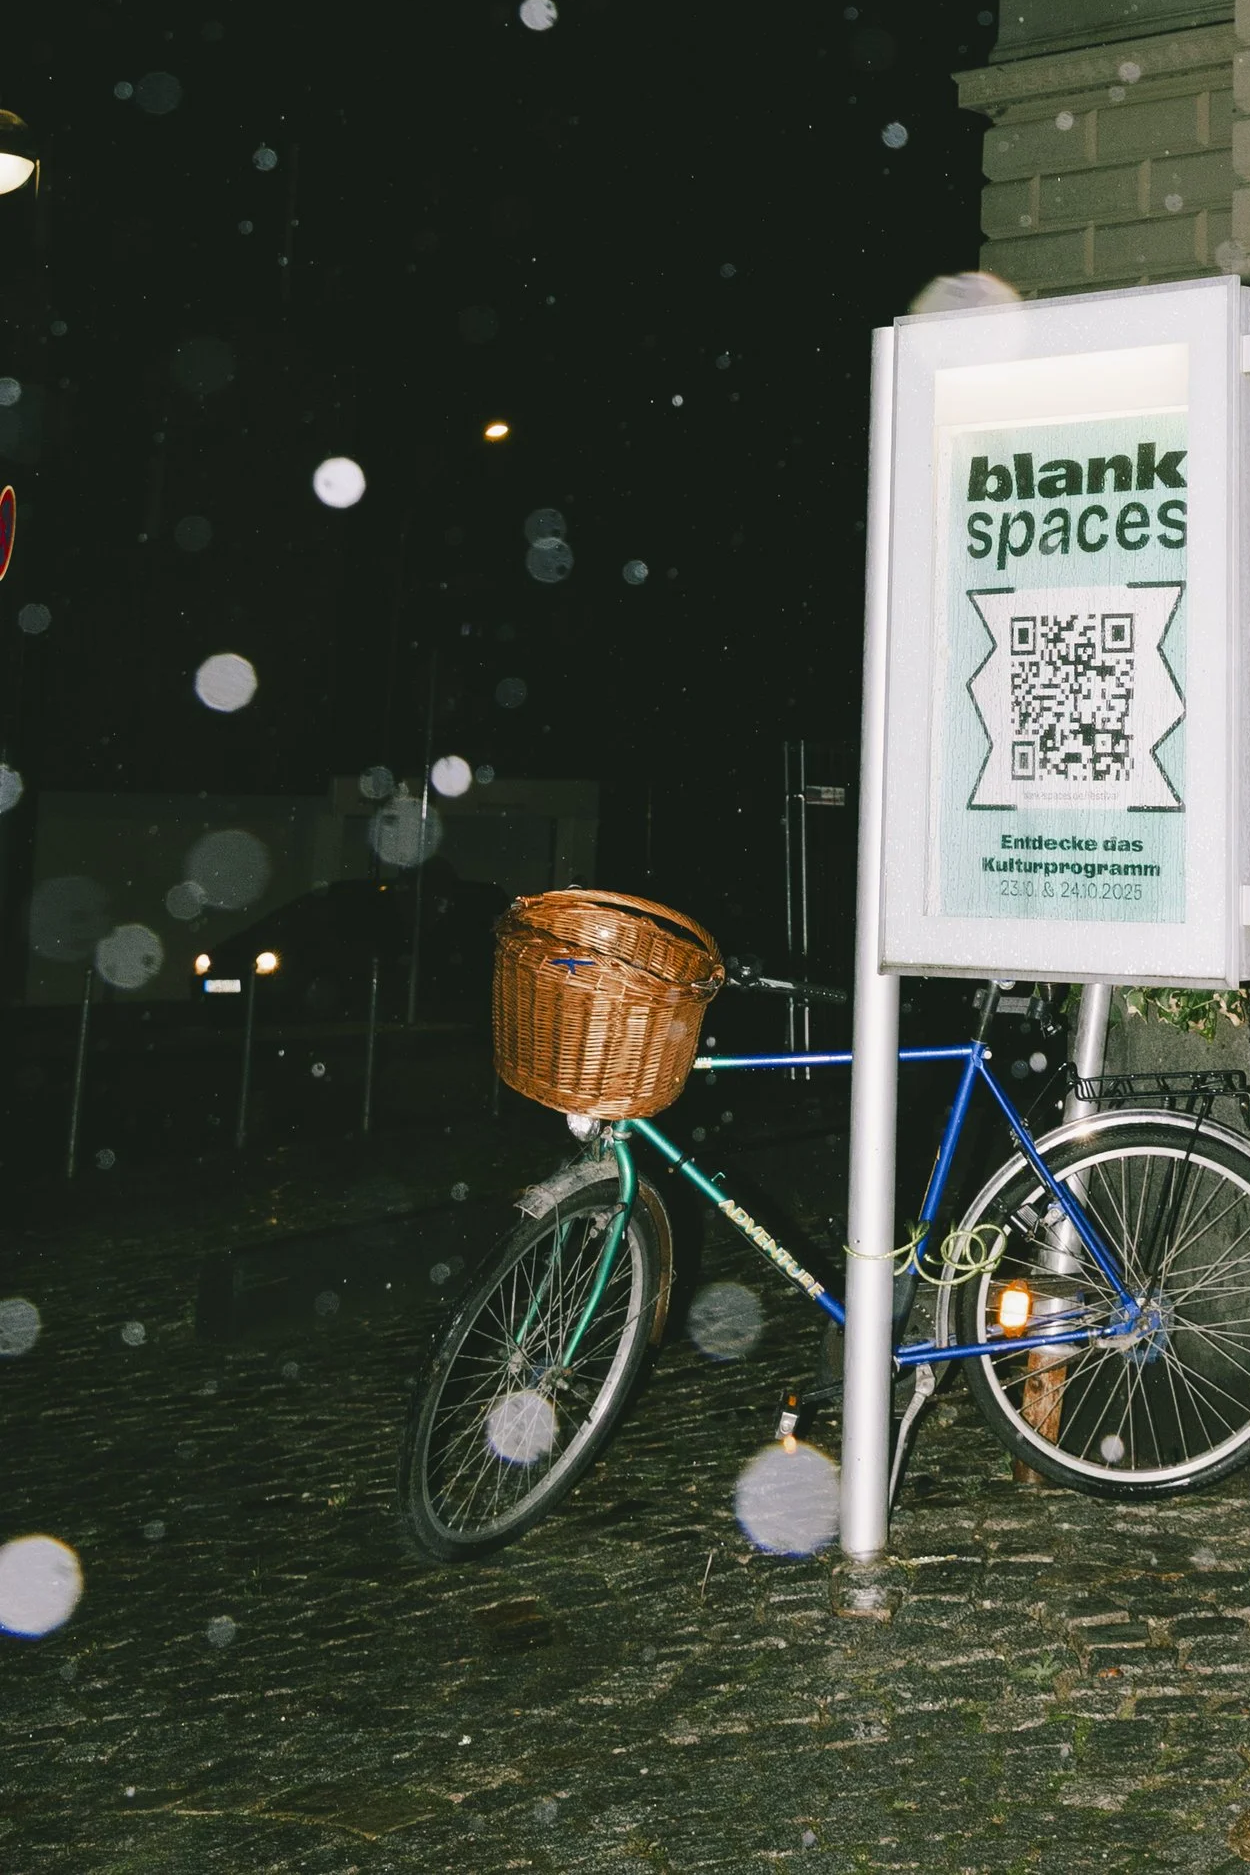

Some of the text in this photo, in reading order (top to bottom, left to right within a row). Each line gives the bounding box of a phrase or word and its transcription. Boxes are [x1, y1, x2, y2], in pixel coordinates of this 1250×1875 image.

[967, 442, 1188, 502] blank
[966, 499, 1188, 571] spaces
[1001, 834, 1144, 852] Entdecke das
[982, 857, 1161, 879] Kulturprogramm
[1042, 881, 1055, 899] &
[1061, 882, 1142, 900] 24.10.2025
[719, 1200, 825, 1300] ADVENTURE
